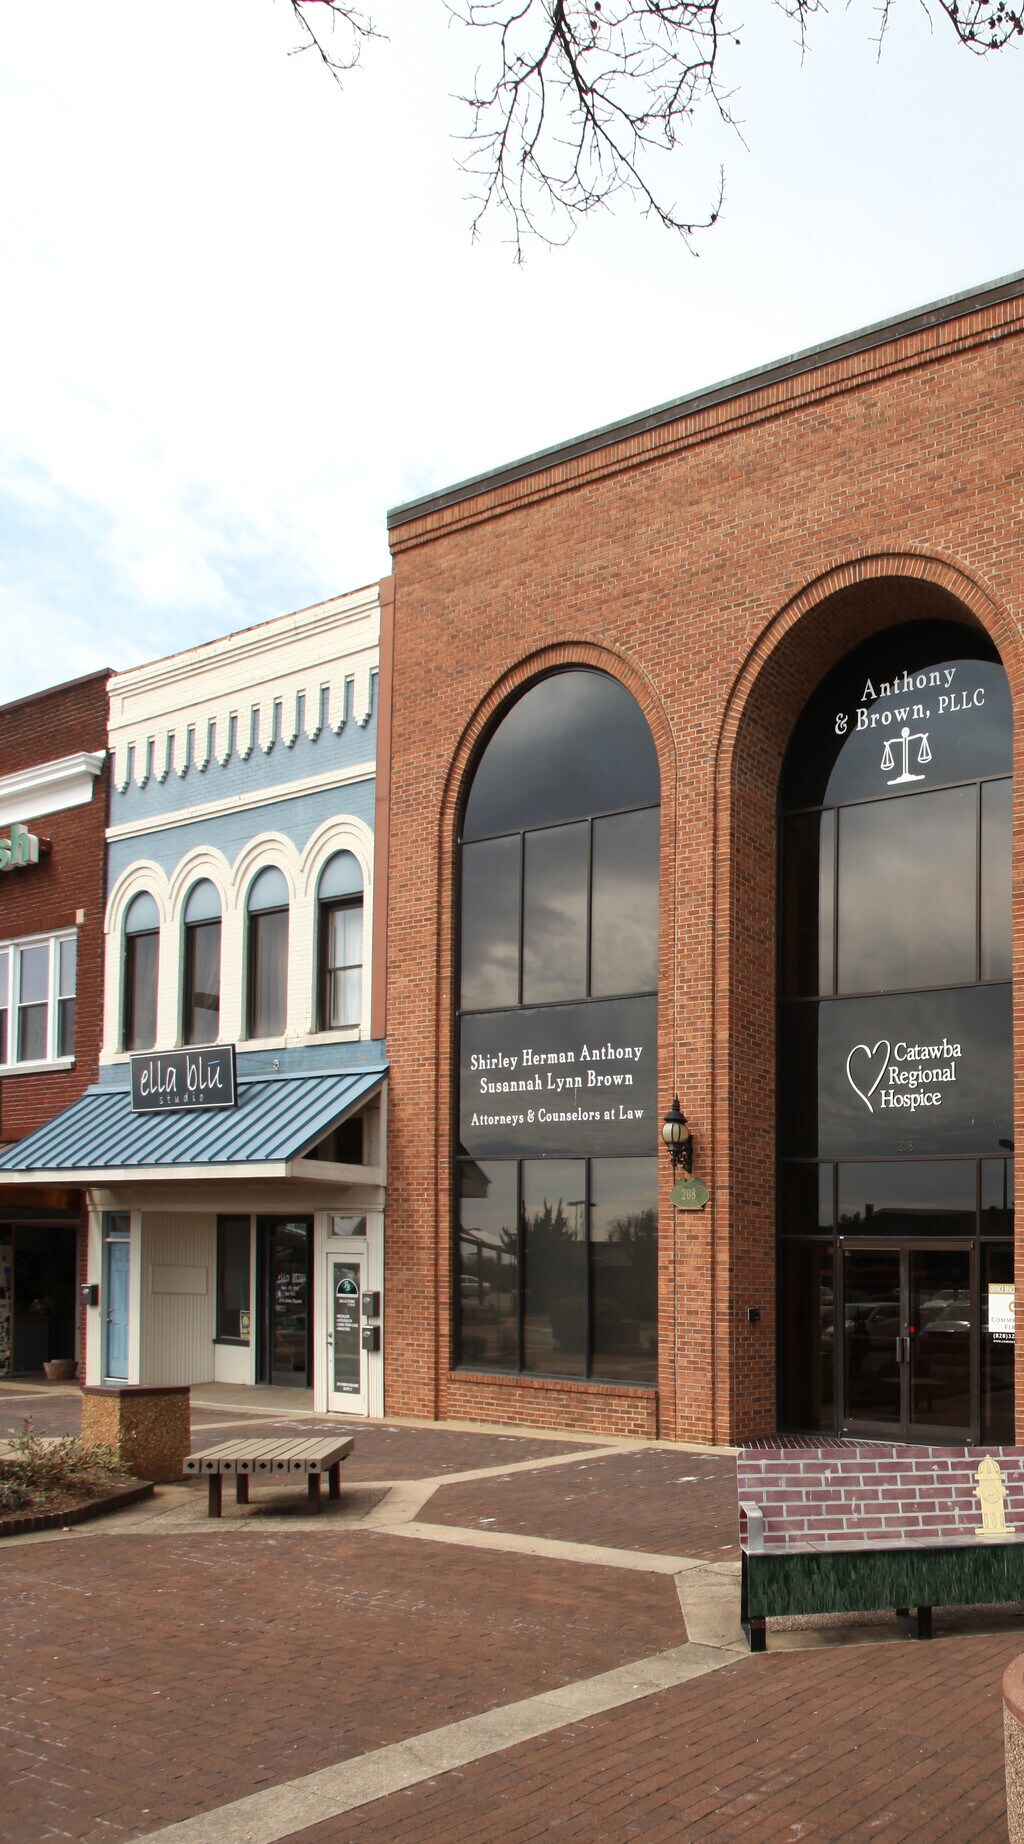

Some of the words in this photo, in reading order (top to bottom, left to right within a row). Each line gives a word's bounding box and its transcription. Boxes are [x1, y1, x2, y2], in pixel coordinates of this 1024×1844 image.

[860, 668, 957, 701] Anthony
[834, 713, 849, 735] &
[855, 702, 931, 731] Brown,
[937, 688, 985, 714] PLLC
[470, 1052, 518, 1070] Shirley
[522, 1049, 575, 1066] Herman
[580, 1043, 643, 1062] Anthony
[894, 1038, 962, 1061] Catawba
[140, 1060, 177, 1096] ella
[480, 1074, 542, 1093] Susannah
[546, 1072, 582, 1091] Lynn
[587, 1069, 633, 1087] Brown
[888, 1061, 956, 1088] Regional
[159, 1091, 204, 1104] studio
[880, 1088, 942, 1112] Hospice
[471, 1112, 524, 1127] Attorneys
[527, 1109, 535, 1123] &
[538, 1107, 600, 1122] Counselors
[604, 1108, 616, 1120] at
[619, 1105, 644, 1120] Law
[681, 1188, 697, 1200] 208
